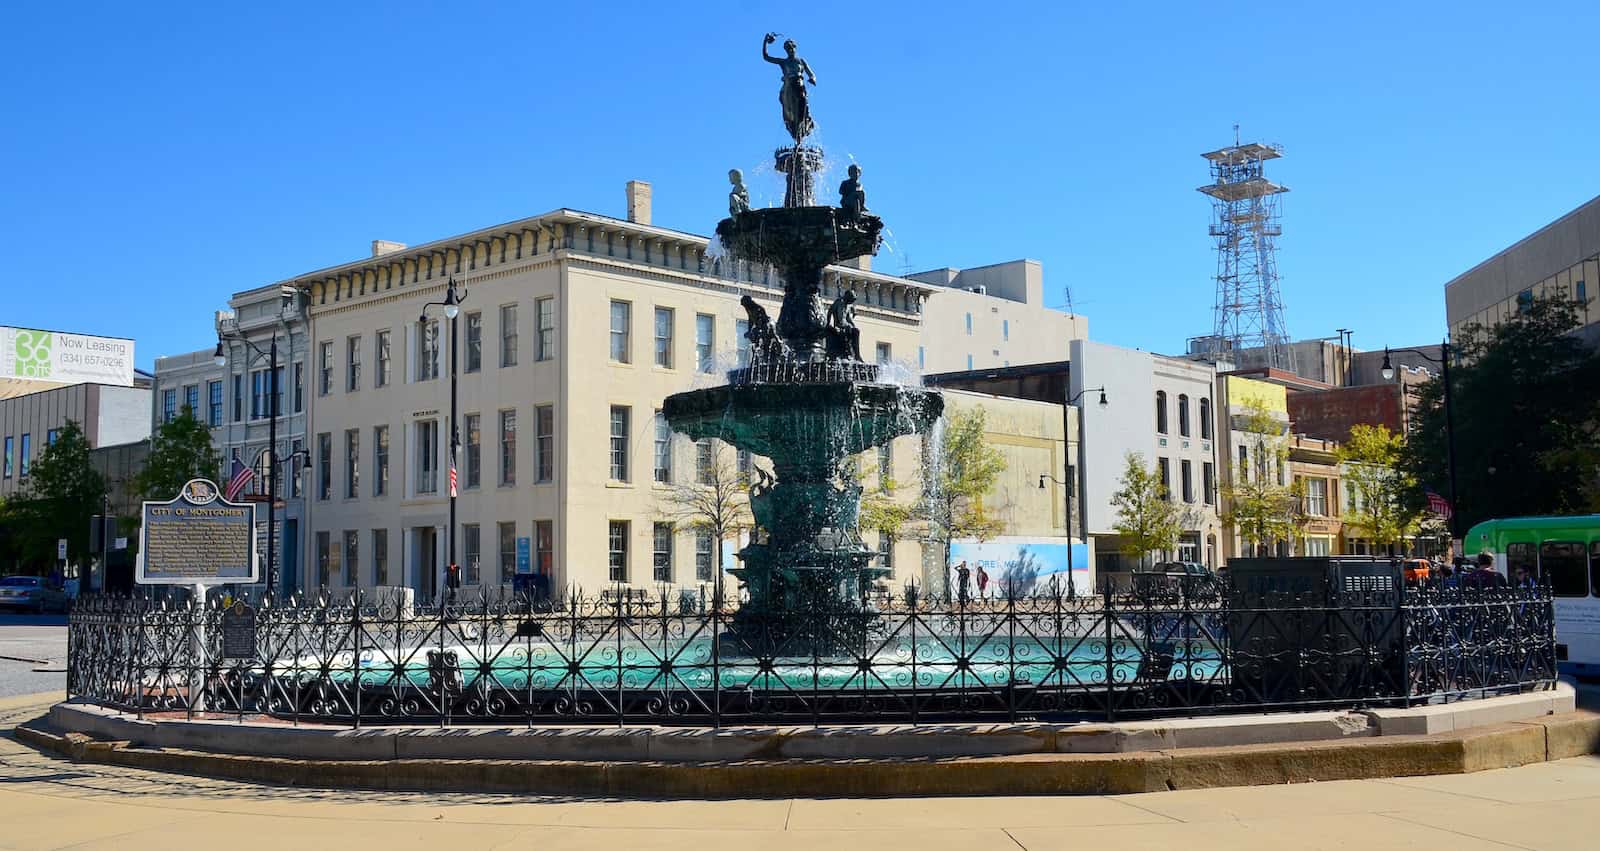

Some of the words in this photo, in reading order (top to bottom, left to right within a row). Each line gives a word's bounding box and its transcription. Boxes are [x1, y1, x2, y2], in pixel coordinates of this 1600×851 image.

[16, 331, 51, 361] 36
[60, 336, 82, 349] Now
[86, 339, 125, 356] Leasing
[60, 353, 82, 365] (334)
[85, 355, 124, 368] 657-0296
[151, 507, 170, 516] CITY
[175, 507, 185, 516] OF
[190, 508, 246, 517] MONTGOMERY
